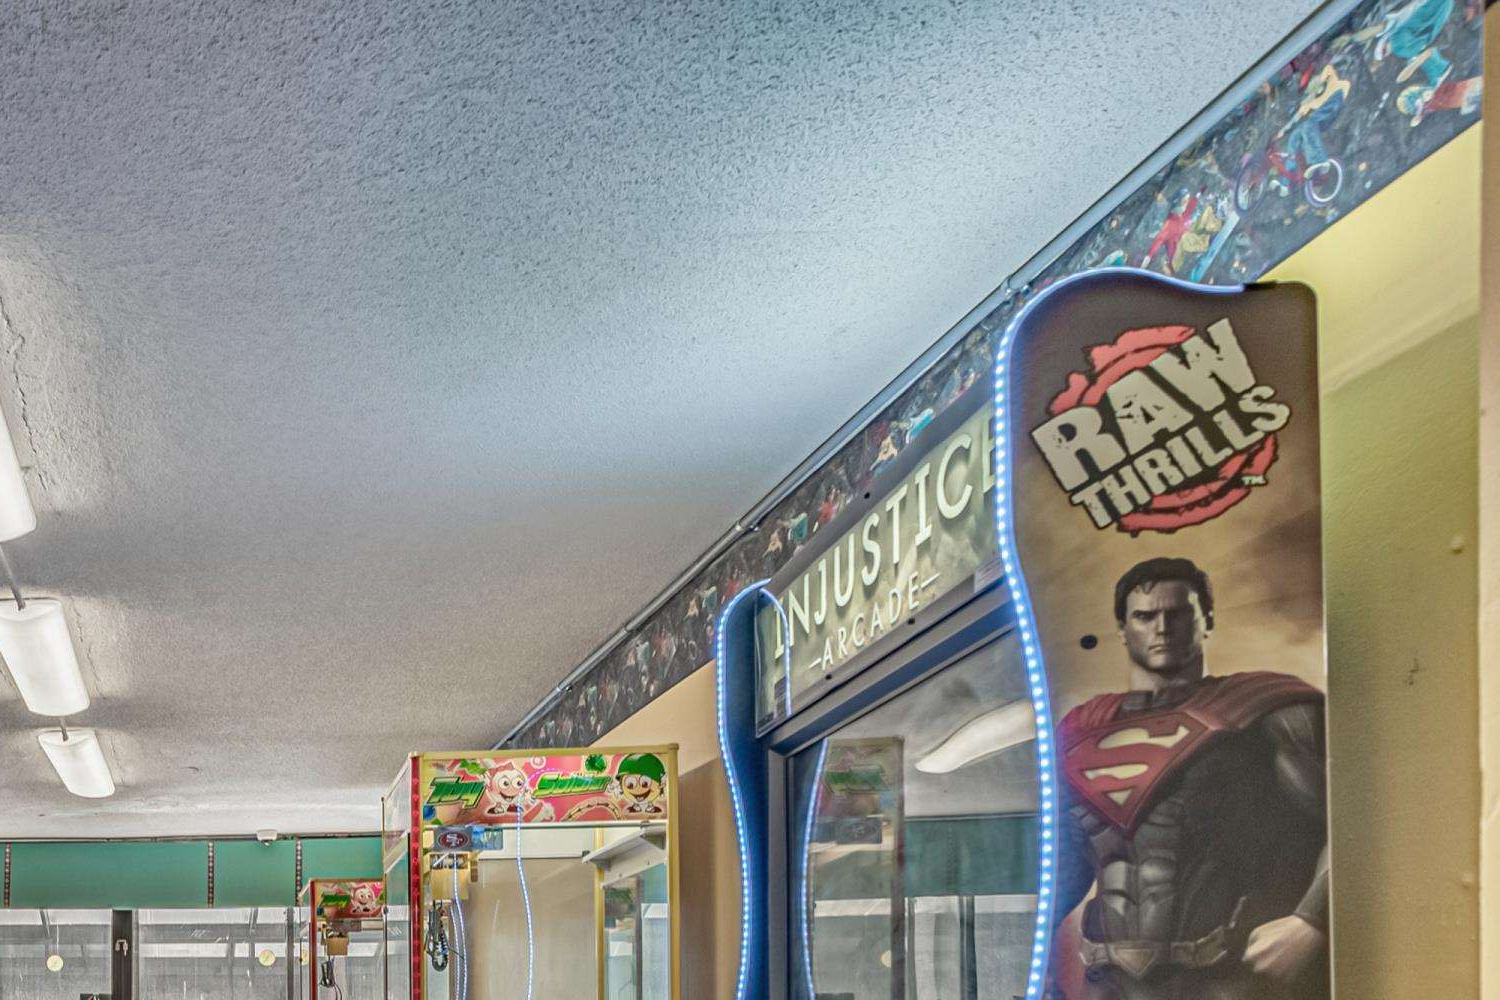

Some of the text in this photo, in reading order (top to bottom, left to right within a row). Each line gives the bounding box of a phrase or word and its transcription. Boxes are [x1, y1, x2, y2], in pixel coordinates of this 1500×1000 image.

[1030, 317, 1257, 492] RAW
[1069, 385, 1291, 529] THRILLS
[822, 571, 920, 671] ARCADE
